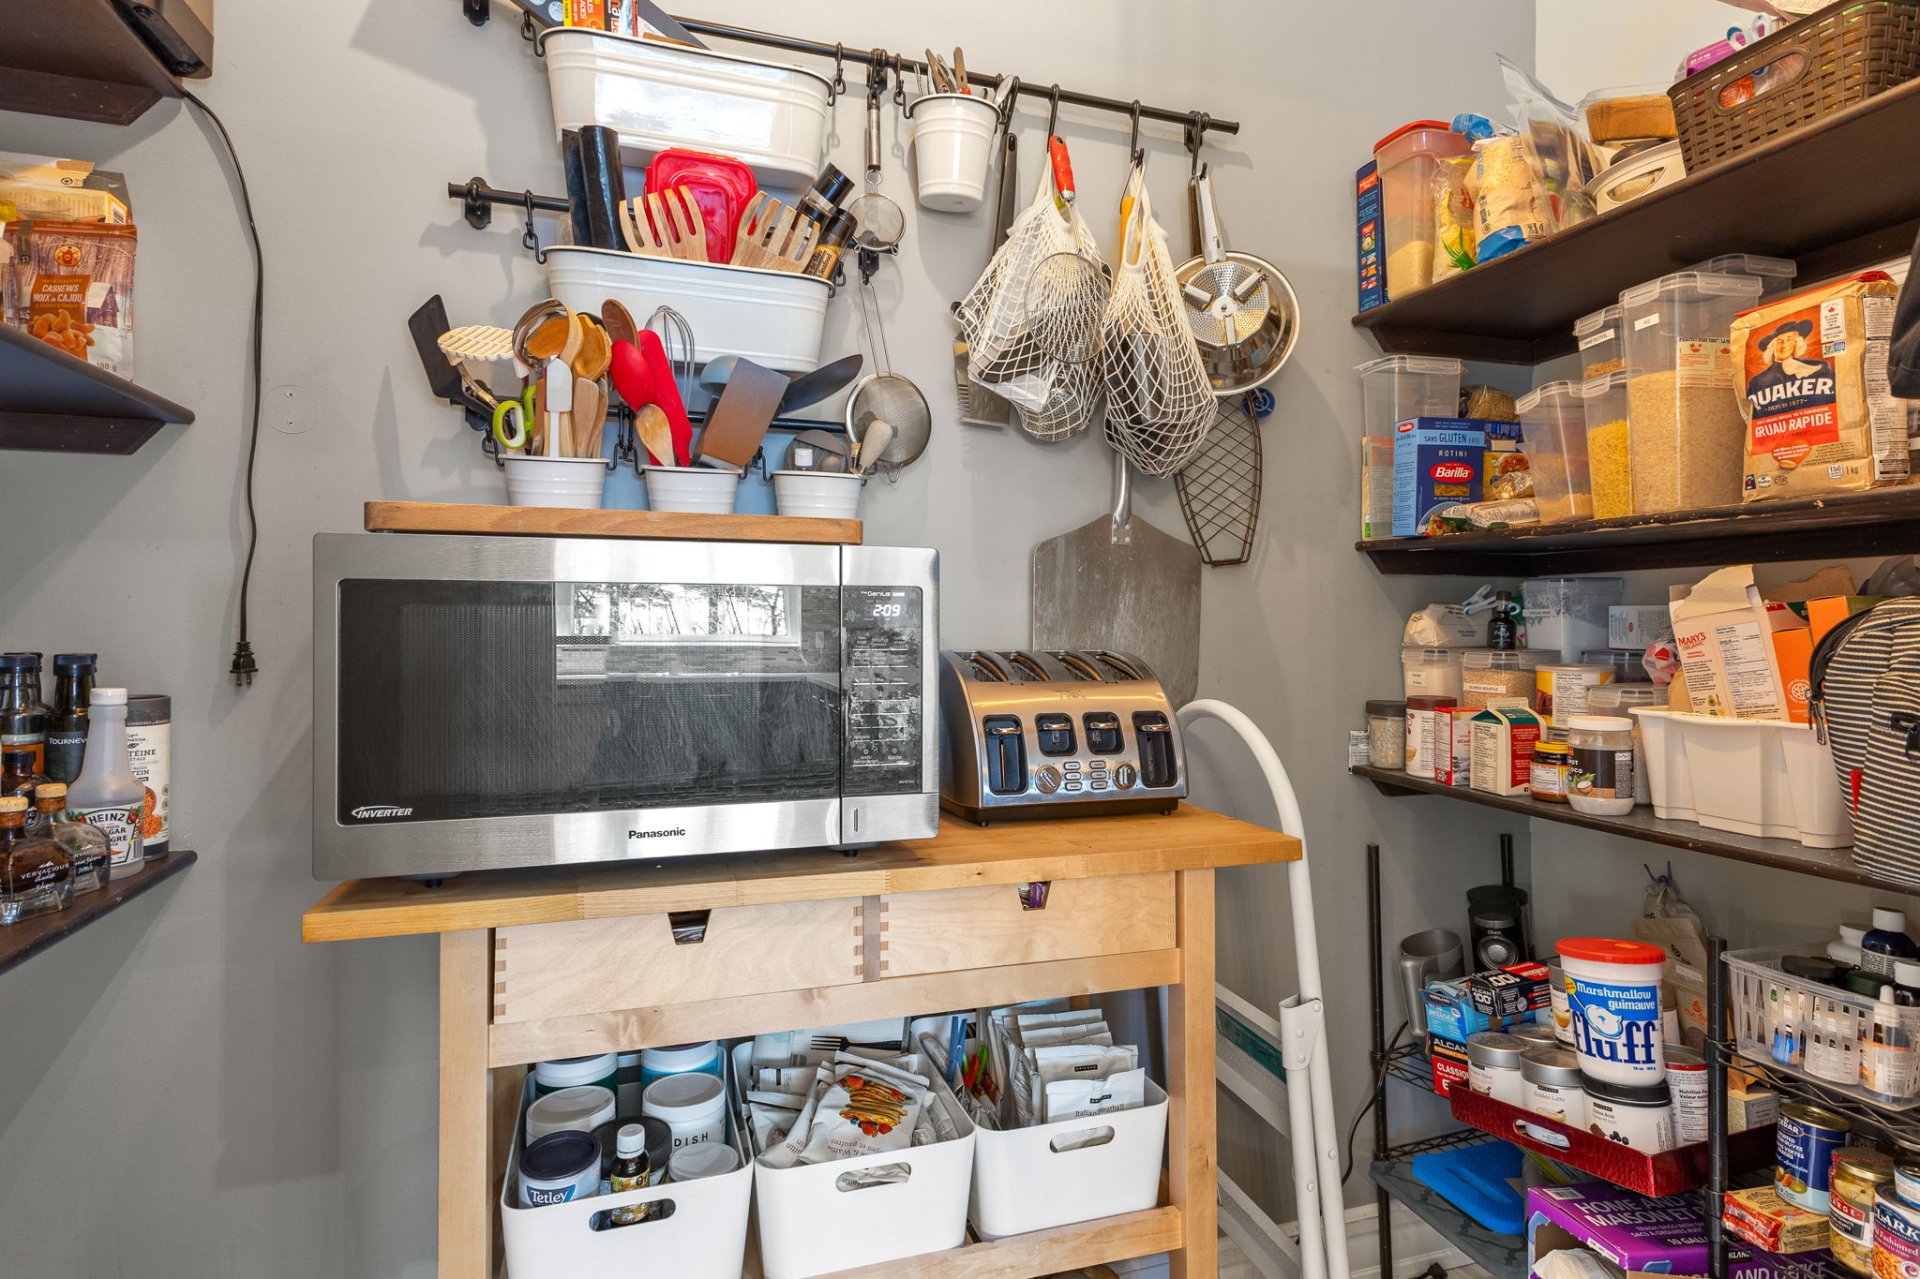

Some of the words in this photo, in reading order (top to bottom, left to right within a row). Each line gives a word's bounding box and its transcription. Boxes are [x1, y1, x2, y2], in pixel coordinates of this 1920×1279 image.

[42, 284, 79, 292] CASHEWS
[33, 293, 51, 302] NOIX
[57, 294, 83, 302] CAJOU
[1748, 377, 1835, 410] QUAKER
[1755, 420, 1787, 438] GRUAU
[1789, 411, 1833, 431] RAPIDE
[1439, 432, 1467, 443] GLUTEN
[1438, 449, 1468, 457] ROTINI
[1435, 466, 1469, 478] Barilla
[873, 604, 901, 617] 2:09
[1678, 631, 1707, 647] MARY'S
[88, 812, 126, 825] HEINZ
[356, 807, 413, 819] INVERTER
[628, 826, 686, 839] Panasonic
[20, 863, 70, 880] VERVACIOUS
[1471, 986, 1492, 996] ALCAN
[1577, 982, 1652, 999] Marshmallow
[1608, 1000, 1656, 1013] guimauve
[1572, 1011, 1657, 1065] fluff
[1074, 1109, 1099, 1117] Italian
[674, 1131, 709, 1147] DISH
[530, 1189, 569, 1204] Tetley
[1574, 1199, 1638, 1214] HOME
[1640, 1197, 1685, 1210] AND
[1584, 1208, 1673, 1226] MAISON
[1667, 1207, 1697, 1220] ET
[1879, 1230, 1919, 1257] Fashioned
